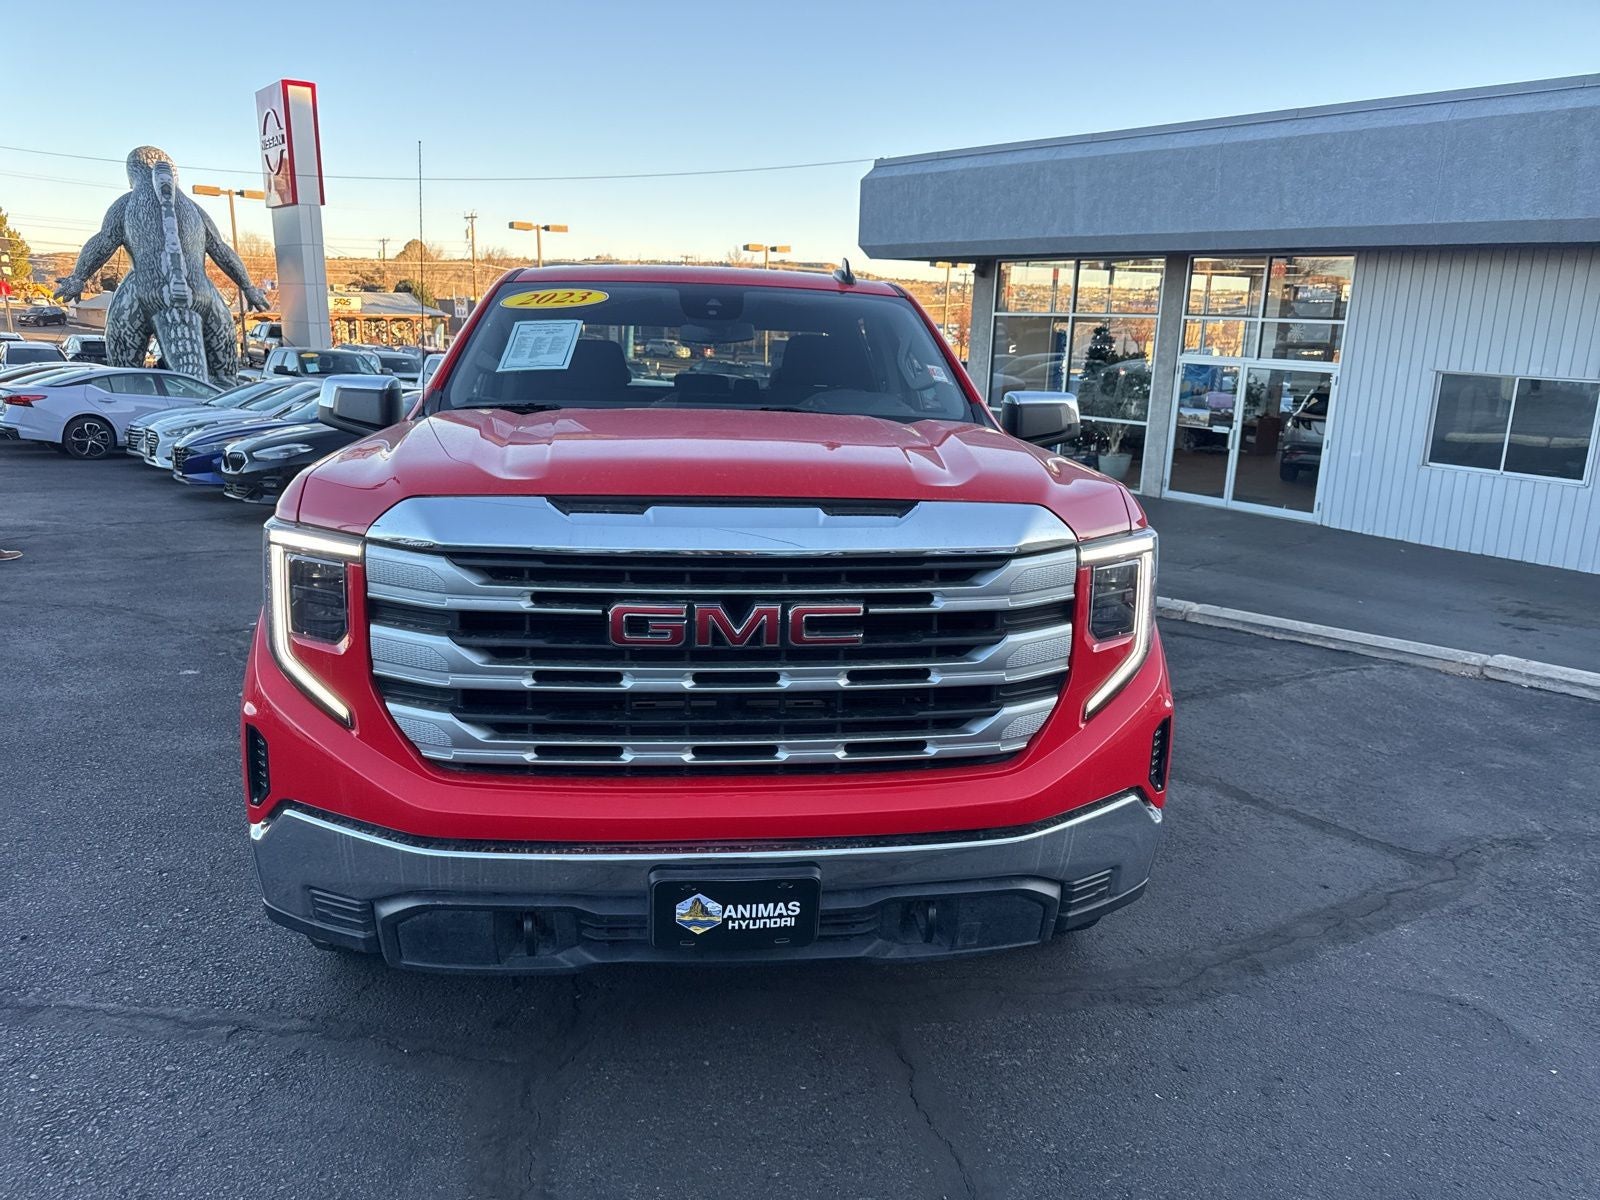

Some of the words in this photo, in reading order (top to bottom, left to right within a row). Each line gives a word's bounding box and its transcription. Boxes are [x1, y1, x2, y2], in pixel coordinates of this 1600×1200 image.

[261, 133, 286, 151] NISSAN
[516, 291, 593, 306] 2023
[608, 603, 864, 647] GMC
[722, 901, 801, 919] ANIMAS
[728, 917, 796, 930] HYUNDAI
